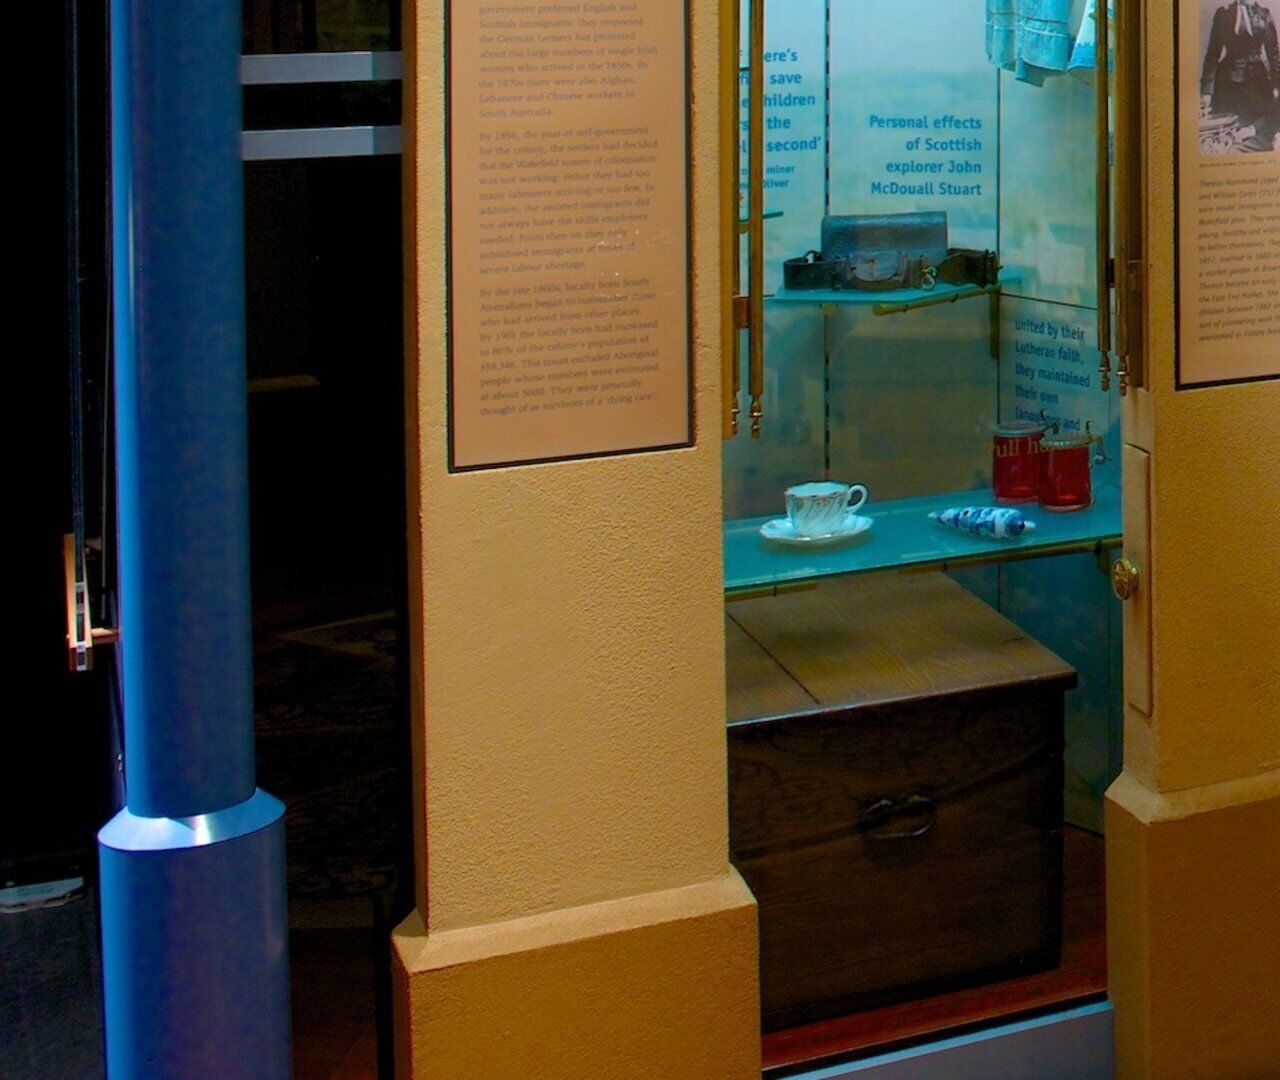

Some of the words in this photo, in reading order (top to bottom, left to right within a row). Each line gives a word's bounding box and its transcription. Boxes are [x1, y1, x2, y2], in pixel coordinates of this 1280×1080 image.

[770, 73, 802, 85] save
[763, 93, 815, 107] hildren
[767, 116, 791, 130] the
[870, 116, 928, 129] Personal
[933, 116, 982, 130] effects
[905, 138, 920, 151] of
[925, 138, 982, 151] Scottish
[766, 164, 795, 175] miner
[886, 161, 943, 176] explorer
[947, 161, 982, 174] John
[871, 182, 933, 196] McDouall
[939, 182, 982, 196] Stuart
[1016, 319, 1044, 334] united
[1047, 322, 1058, 339] by
[1061, 324, 1085, 341] their
[1016, 341, 1055, 358] Lutheran
[1059, 347, 1084, 365] faith,
[1016, 363, 1035, 380] they
[1039, 368, 1090, 387] maintained
[1016, 384, 1037, 400] their
[1041, 392, 1059, 404] own
[1063, 418, 1080, 430] and
